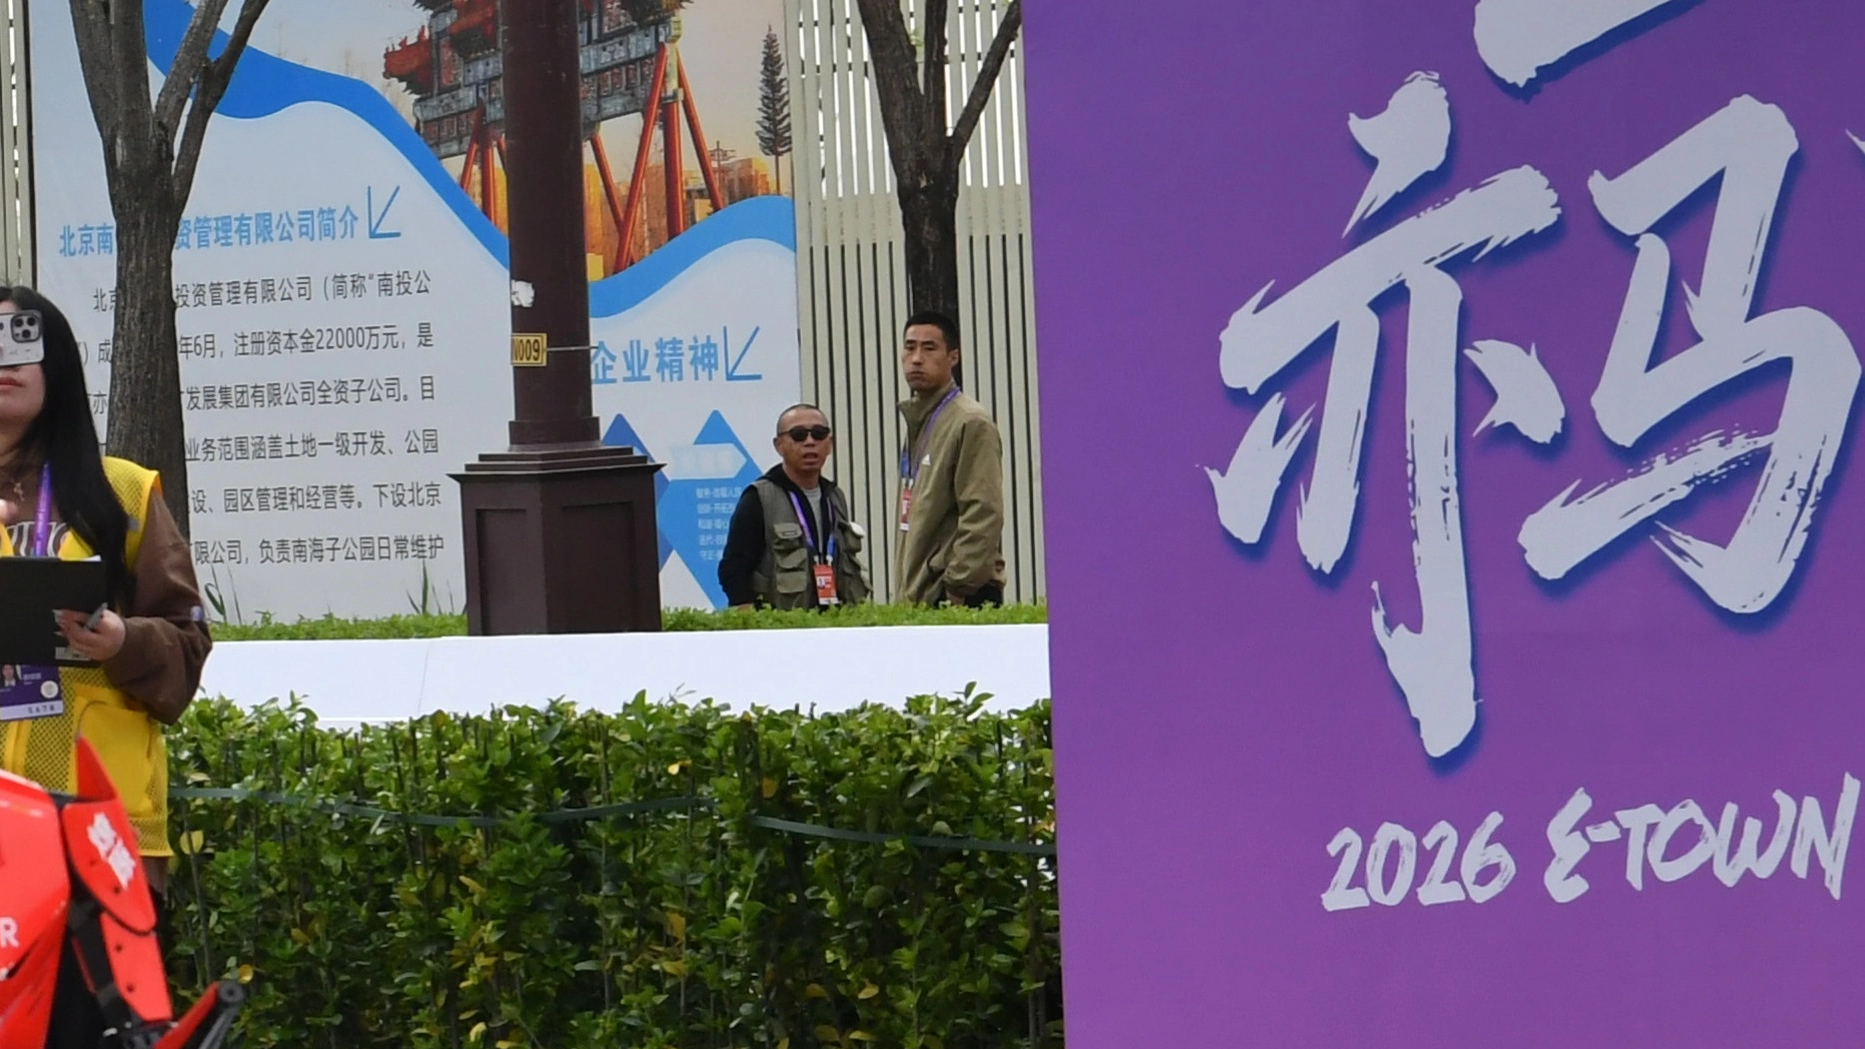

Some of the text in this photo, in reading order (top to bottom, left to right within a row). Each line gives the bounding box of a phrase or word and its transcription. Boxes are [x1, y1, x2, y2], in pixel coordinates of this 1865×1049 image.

[591, 335, 720, 385] 企业精神
[1321, 771, 1862, 912] 2026 E-TOWN
